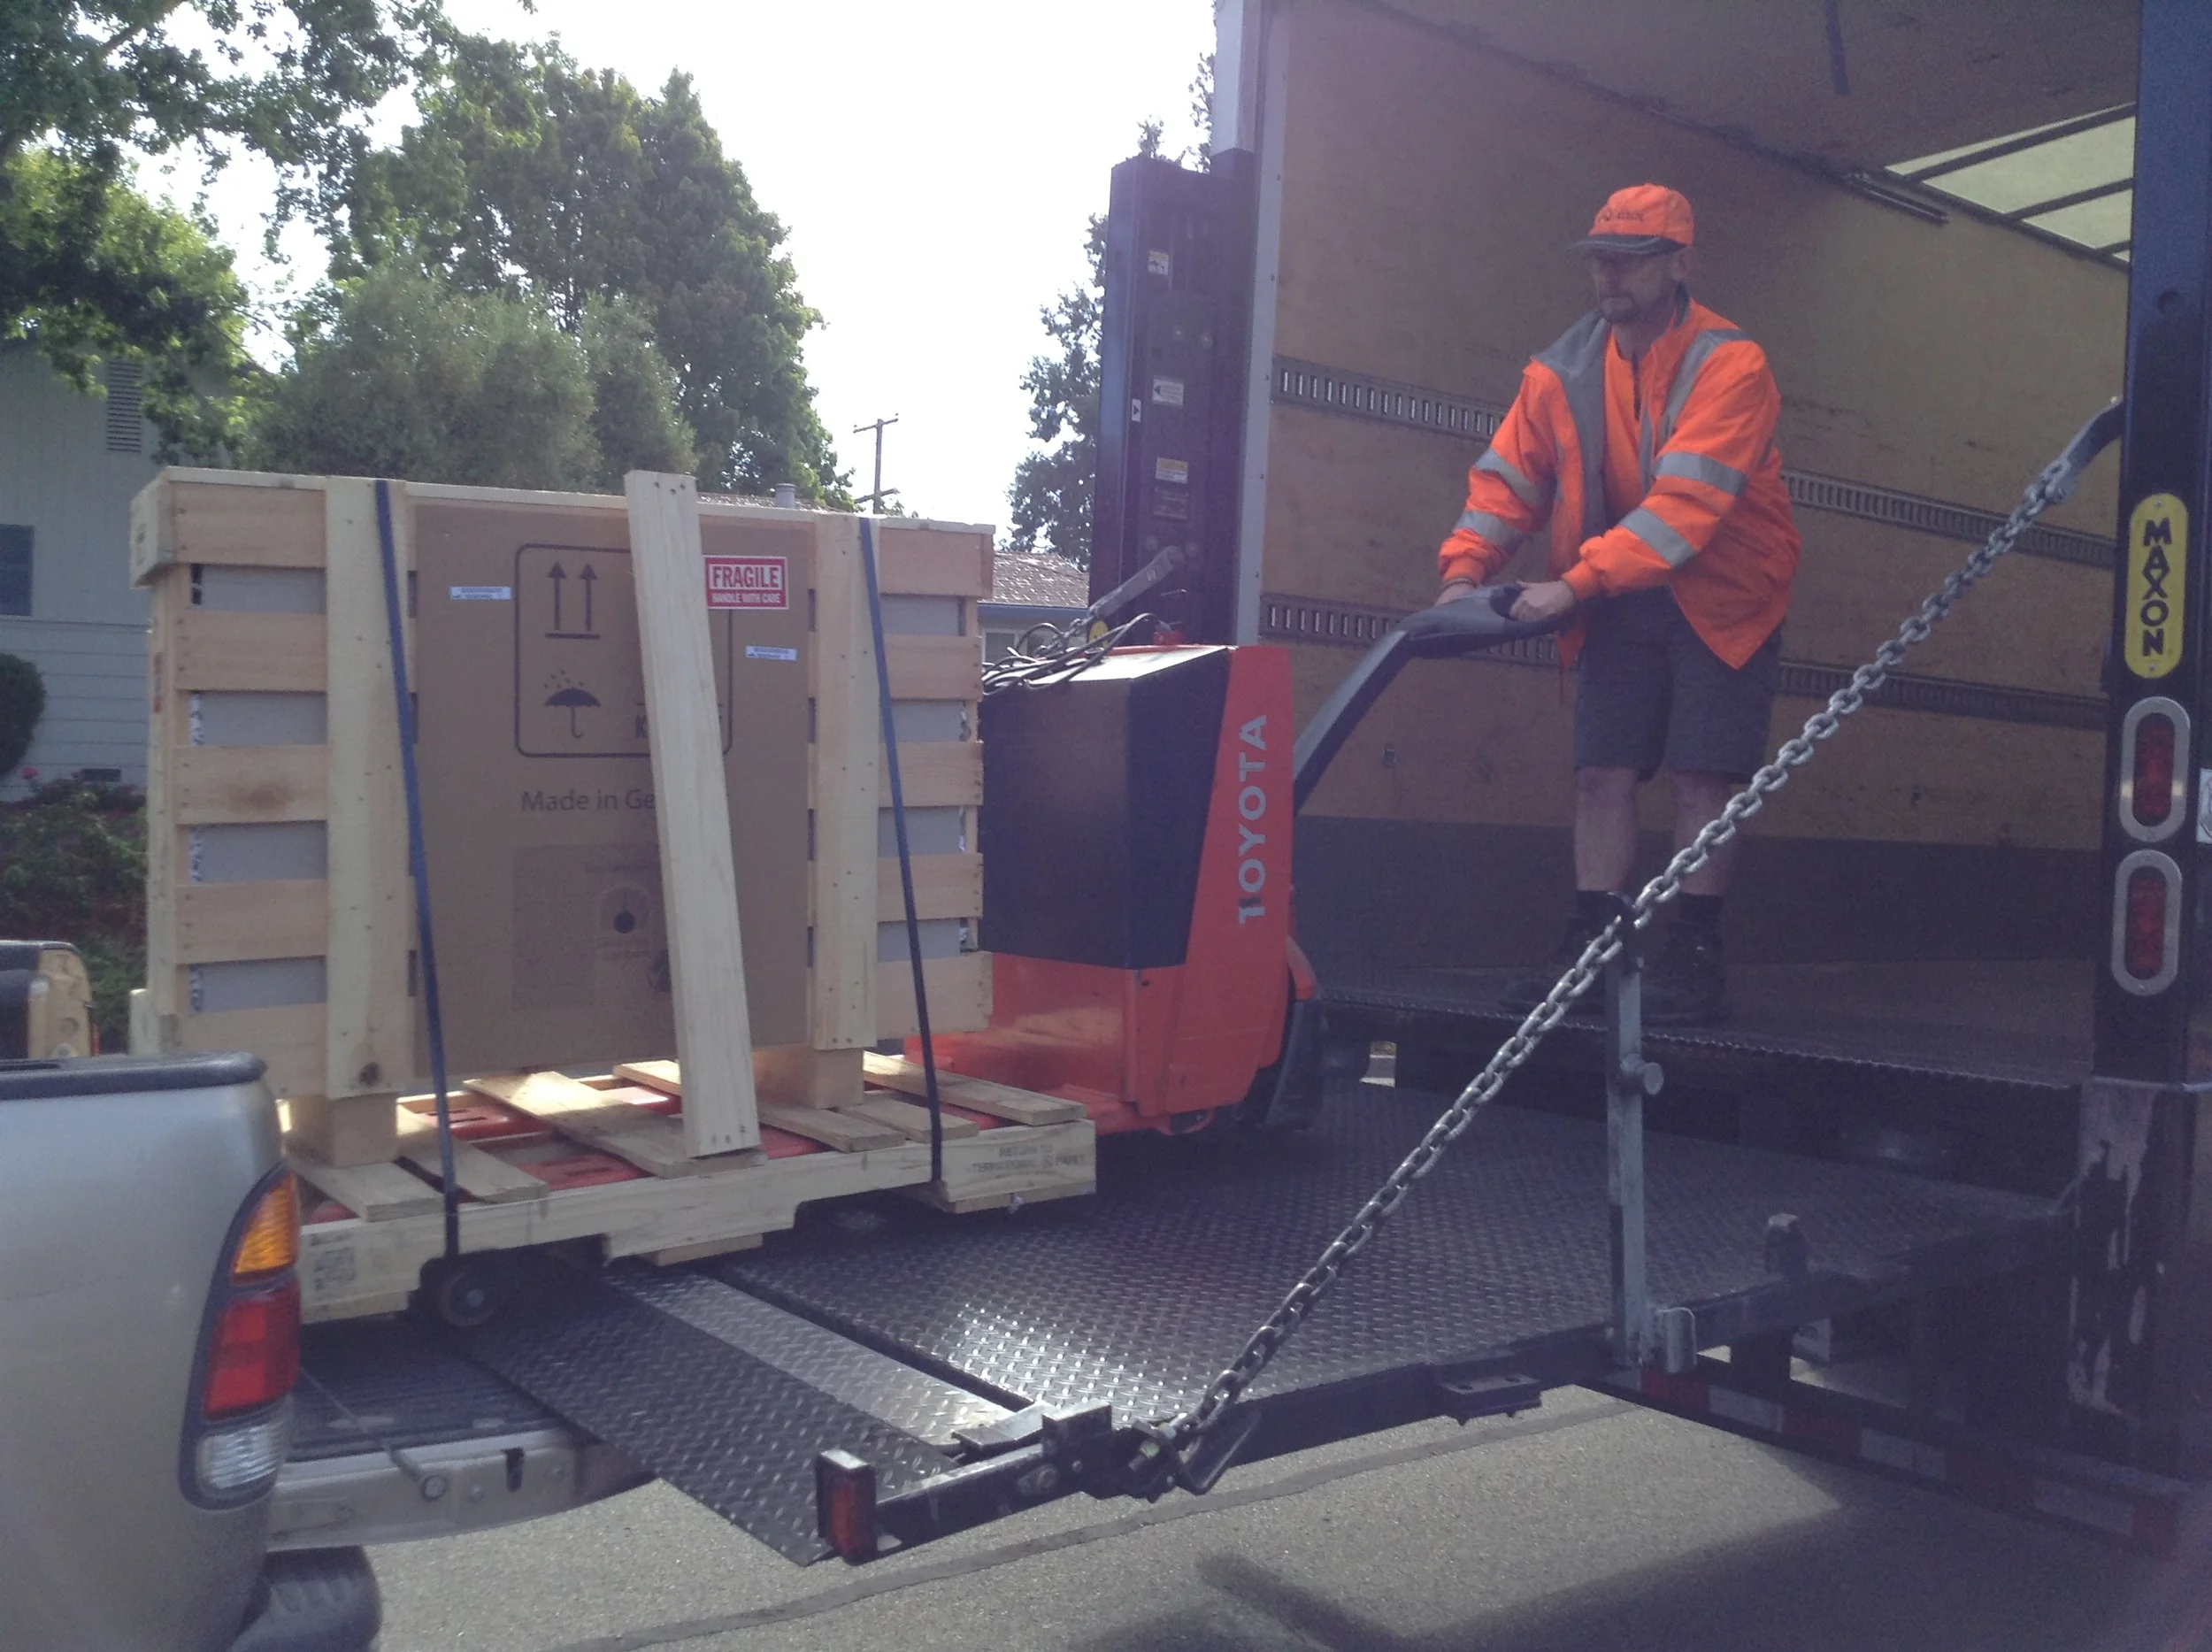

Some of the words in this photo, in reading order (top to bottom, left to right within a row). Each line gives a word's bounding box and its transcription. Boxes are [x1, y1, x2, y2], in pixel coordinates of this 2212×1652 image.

[711, 565, 780, 588] FRAGILE
[2140, 517, 2172, 657] MAXON
[520, 789, 590, 812] Made
[596, 789, 618, 811] in
[1238, 713, 1268, 926] TOYOTA
